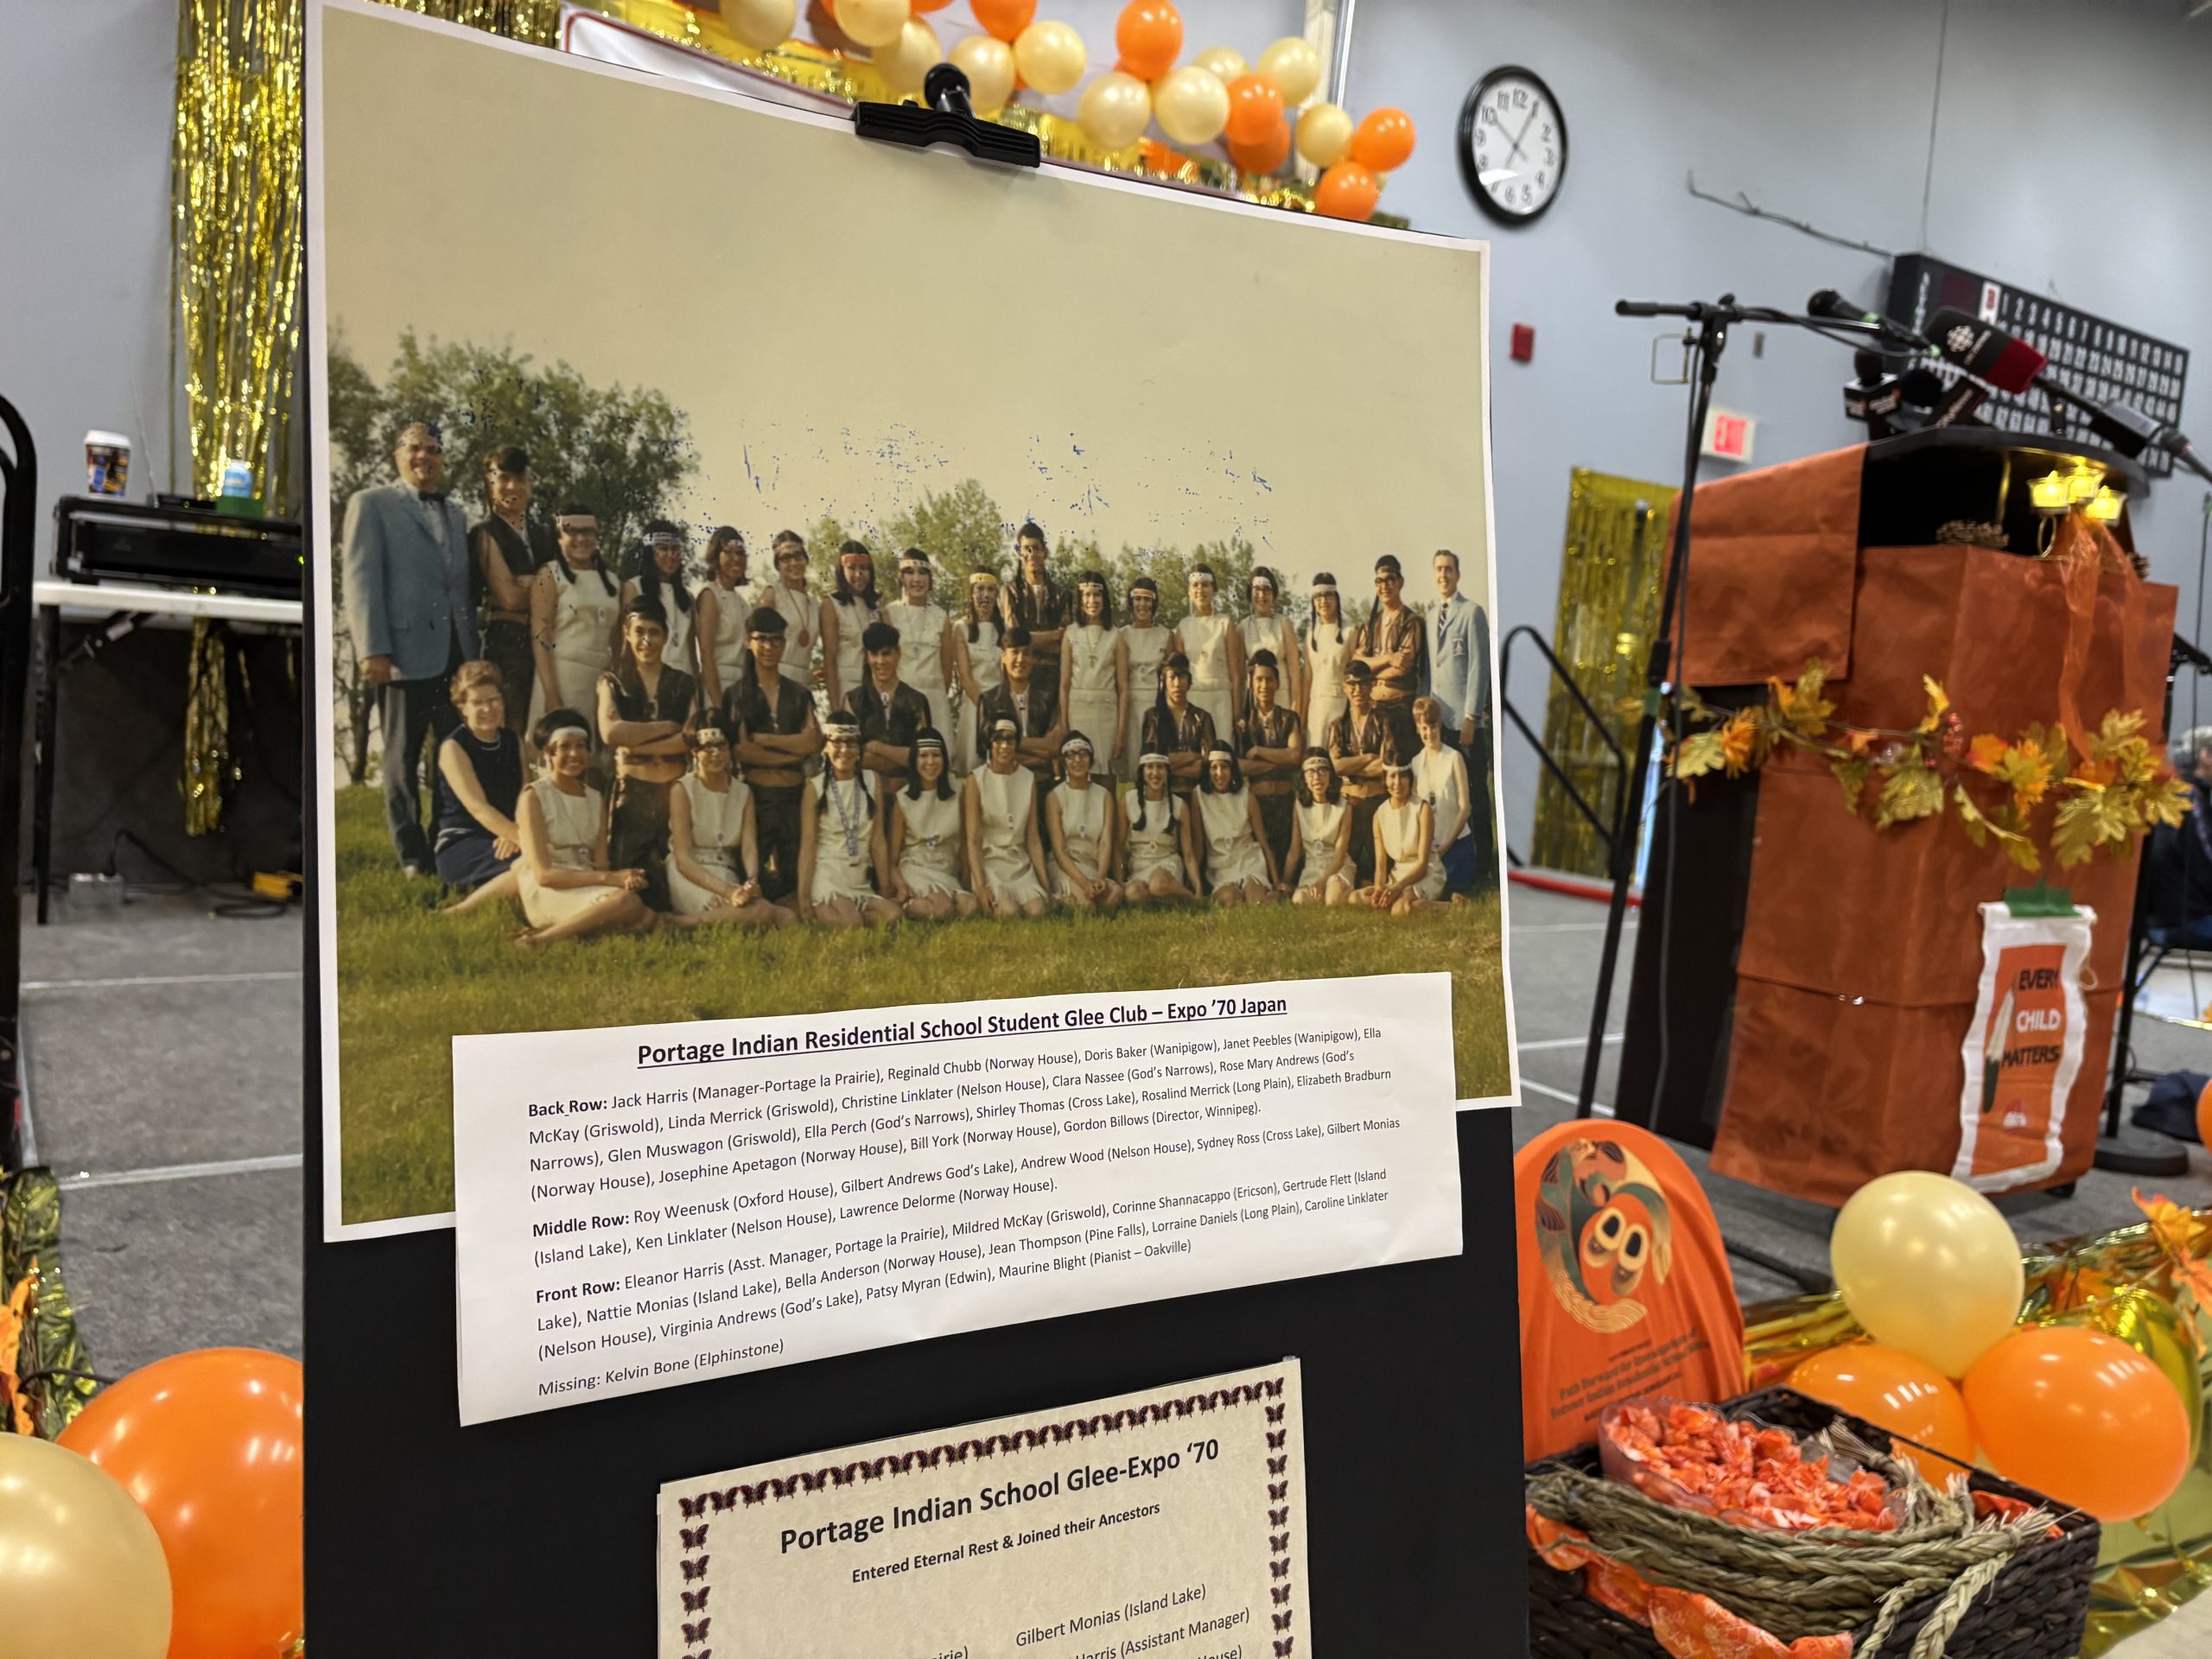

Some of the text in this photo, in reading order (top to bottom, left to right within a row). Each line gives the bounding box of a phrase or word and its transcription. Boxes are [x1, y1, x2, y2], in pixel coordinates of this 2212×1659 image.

[1482, 105, 1497, 125] 10
[1497, 91, 1510, 111] 11
[1513, 88, 1528, 109] 12
[1475, 129, 1486, 147] 9
[1541, 123, 1551, 143] 2
[639, 1040, 725, 1065] Portage
[732, 1034, 798, 1056] Indian
[805, 1021, 914, 1050] Residential
[919, 1016, 982, 1039] School
[988, 1012, 1059, 1033] Student
[1065, 1009, 1104, 1027] Glee
[1109, 1005, 1147, 1023] Club
[1167, 1002, 1207, 1020] Expo
[1240, 996, 1287, 1015] Japan
[2016, 1008, 2061, 1033] CHILD
[528, 1027, 1382, 1117] Back Row: Jack Harris (Manager-Portage la Prairie), Reginald Chubb (Norway House), Doris Baker (Wanipigow), Janet Peebles (Wanipigow), Ella
[2001, 1045, 2060, 1069] MATTERS
[529, 1128, 580, 1145] McKay
[583, 1116, 664, 1141] (Griswold),
[668, 1112, 705, 1129] Linda
[709, 1105, 763, 1125] Merrick
[766, 1097, 838, 1121] (Griswold),
[841, 1092, 898, 1109] Christine
[900, 1087, 954, 1103] Linklater
[956, 1082, 1001, 1100] (Nelson
[1005, 1075, 1049, 1092] House),
[1052, 1074, 1082, 1087] Clara
[1084, 1071, 1124, 1084] Nassee
[1165, 1061, 1217, 1077] Narrows),
[1219, 1060, 1244, 1072] Rose
[1246, 1058, 1274, 1071] Mary
[1274, 1053, 1319, 1067] Andrews
[530, 1149, 603, 1173] Narrows),
[607, 1147, 641, 1163] Glen
[646, 1139, 723, 1159] Muswagon
[727, 1127, 801, 1152] (Griswold),
[804, 1123, 827, 1139] Ella
[830, 1119, 867, 1136] Perch
[914, 1107, 973, 1126] Narrows),
[976, 1103, 1016, 1119] Shirley
[1018, 1100, 1065, 1114] Thomas
[1067, 1096, 1103, 1111] (Cross
[1105, 1090, 1139, 1105] Lake),
[1141, 1085, 1187, 1102] Rosalind
[1189, 1082, 1230, 1097] Merrick
[1232, 1081, 1262, 1096] (Long
[1262, 1076, 1294, 1090] Plain),
[1296, 1071, 1342, 1087] Elizabeth
[1344, 1069, 1391, 1083] Bradburn
[536, 1167, 1387, 1304] Front Row: Eleanor Harris (Asst. Manager, Portage la Prairie), Mildred McKay (Griswold), Corinne Shannacappo (Ericson), Gertrude Flett (Island
[537, 1339, 596, 1363] (Nelson
[601, 1325, 657, 1349] House),
[659, 1317, 713, 1338] Virginia
[716, 1307, 777, 1328] Andrews
[825, 1288, 862, 1308] Lake),
[866, 1285, 899, 1300] Patsy
[901, 1277, 941, 1294] Myran
[944, 1267, 995, 1288] (Edwin),
[998, 1261, 1050, 1279] Maurine
[1052, 1255, 1087, 1271] Blight
[1089, 1249, 1132, 1268] (Pianist
[1143, 1238, 1192, 1257] Oakville)
[538, 1338, 784, 1396] Missing: Kelvin Bone (Elphinstone)
[781, 1511, 884, 1554] Portage
[893, 1493, 972, 1529] Indian
[980, 1472, 1059, 1510] School
[1067, 1452, 1180, 1491] Glee-Expo
[852, 1502, 1160, 1583] Entered Eternal Rest & Joined their Ancestors
[1015, 1583, 1206, 1647] Gilbert Monias (Island Lake)
[1121, 1627, 1185, 1659] (Assistant
[1189, 1606, 1249, 1637] Manager)
